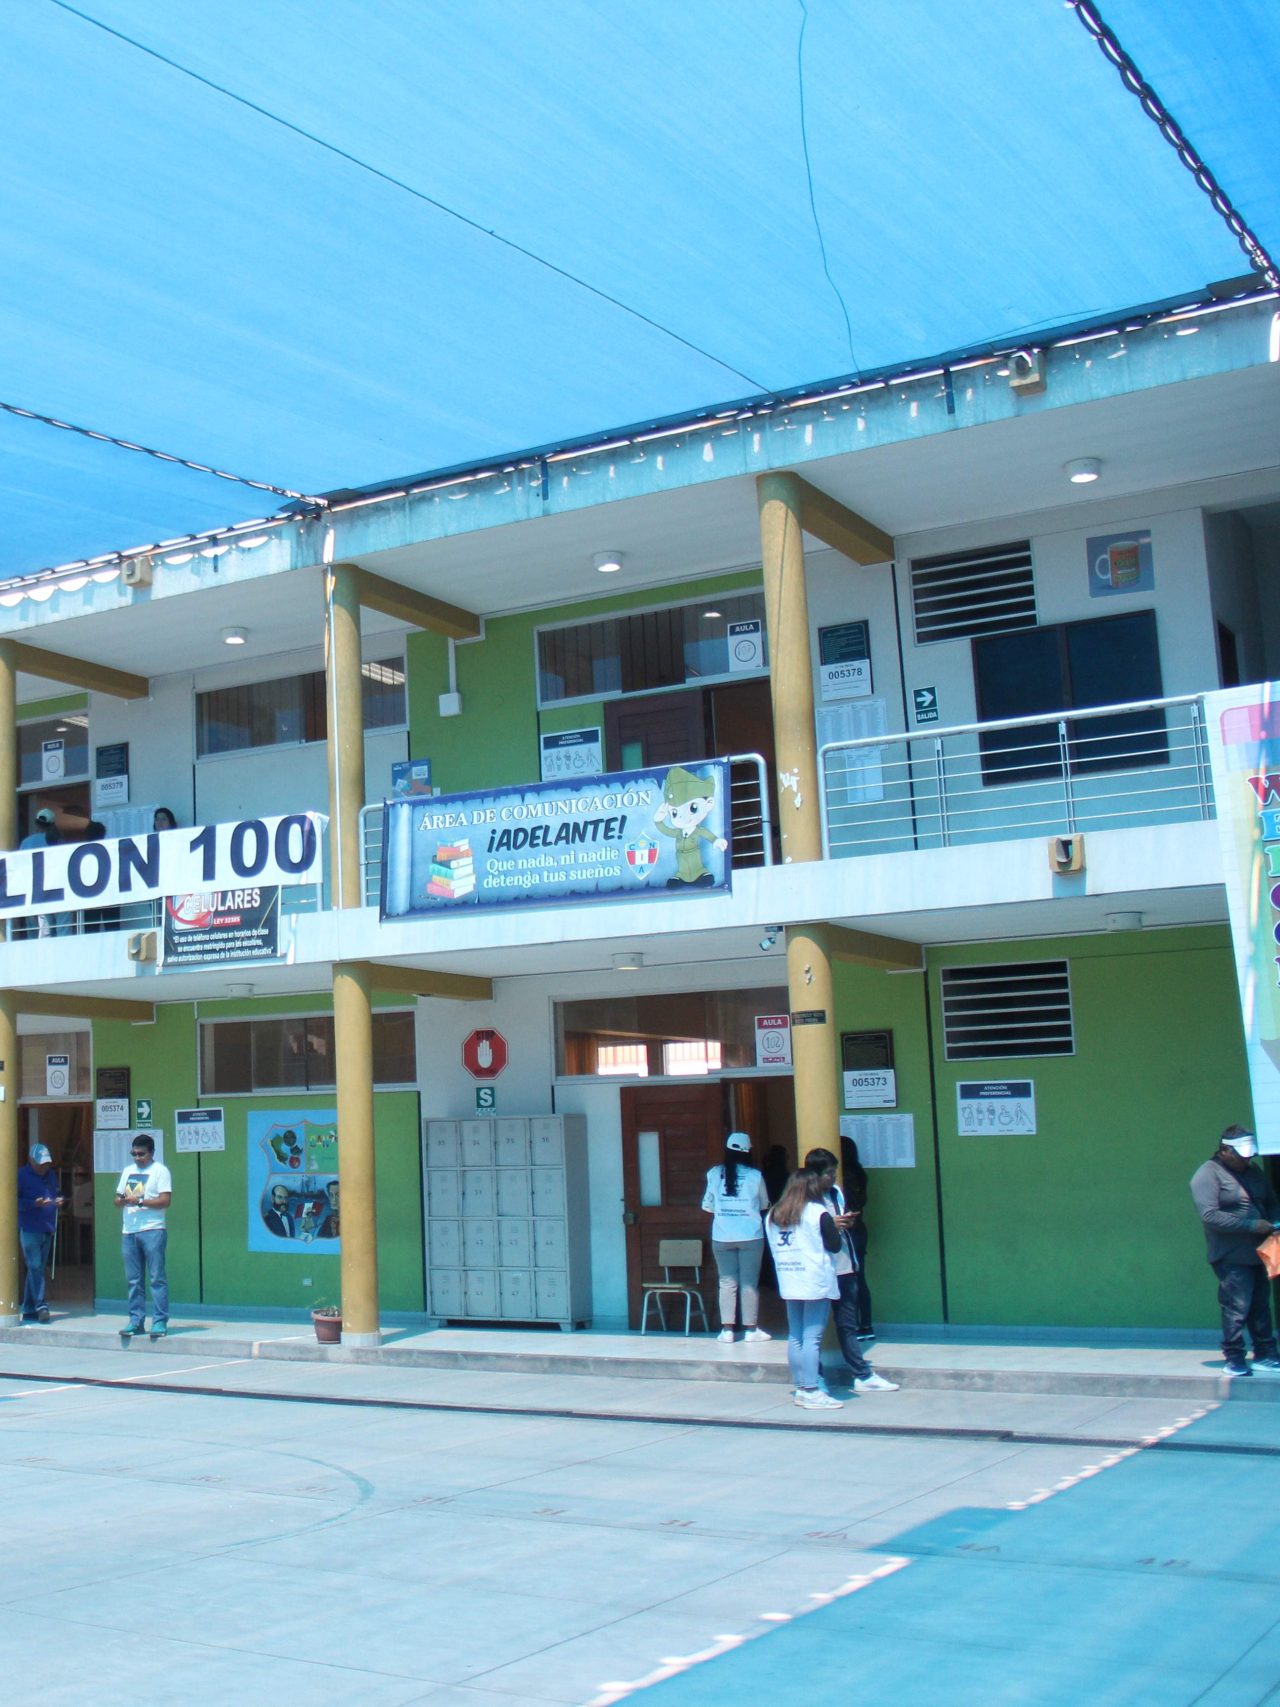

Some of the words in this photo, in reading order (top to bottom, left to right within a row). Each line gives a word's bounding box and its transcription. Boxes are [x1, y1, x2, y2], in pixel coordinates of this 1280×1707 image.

[734, 623, 754, 632] AULA
[828, 667, 863, 680] 005378
[917, 711, 937, 720] SALIDA
[419, 812, 468, 831] ÁREA
[471, 809, 497, 825] DE
[501, 787, 652, 821] COMUNICACIÓN
[487, 814, 628, 854] ¡ADELANTE!
[189, 813, 317, 882] 100
[487, 858, 515, 873] Que
[518, 854, 558, 869] nada,
[560, 850, 575, 865] ni
[578, 847, 619, 863] nadie
[483, 872, 540, 889] detenga
[543, 869, 567, 883] tus
[569, 863, 622, 881] sueños
[184, 888, 260, 915] CELULARES
[214, 917, 224, 925] LEY
[762, 1018, 783, 1026] AULA
[766, 1036, 781, 1049] 102
[851, 1076, 888, 1087] 005373
[480, 1088, 493, 1107] S
[101, 1104, 124, 1113] 005374
